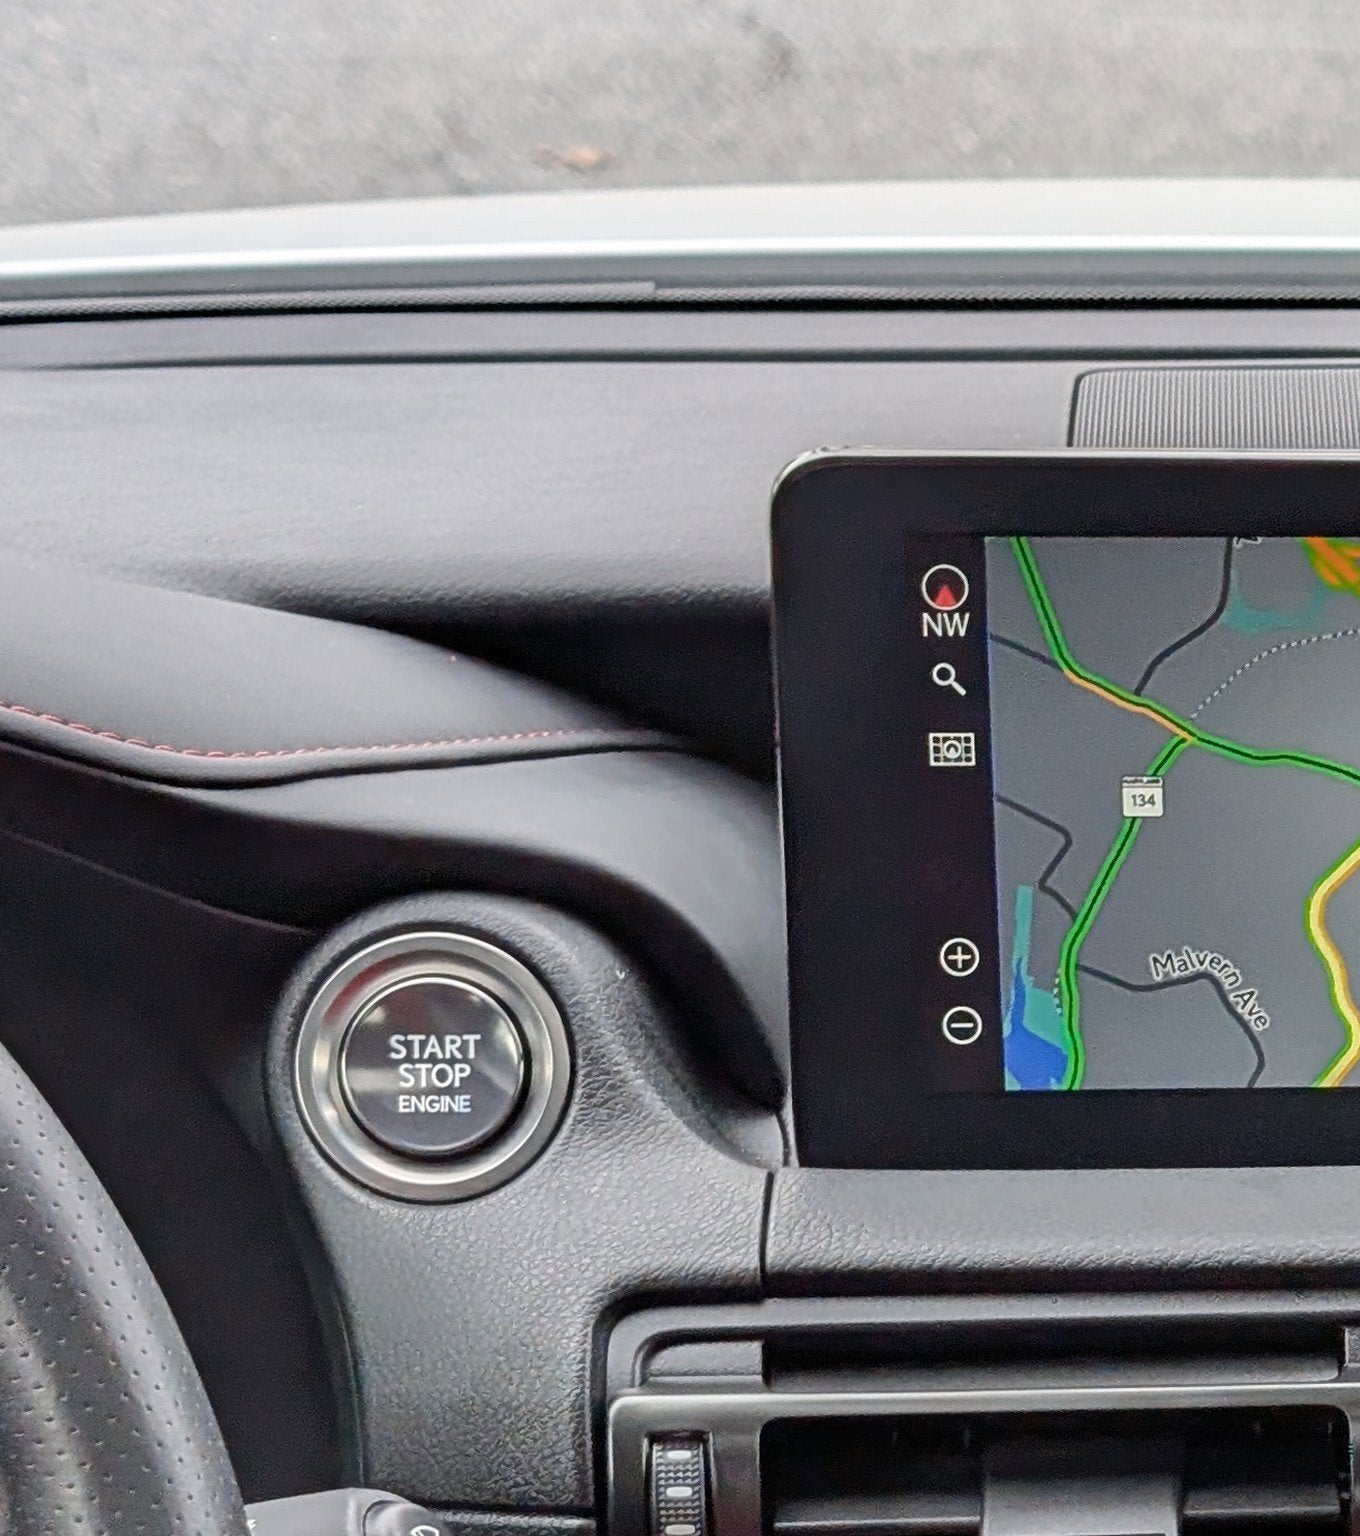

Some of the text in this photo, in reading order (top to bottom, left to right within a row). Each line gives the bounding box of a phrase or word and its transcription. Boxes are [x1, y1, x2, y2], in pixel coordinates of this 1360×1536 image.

[922, 612, 970, 637] NW
[1131, 793, 1156, 807] 134
[1151, 948, 1268, 1029] Malvern Ave
[389, 1033, 482, 1060] START
[398, 1063, 472, 1089] STOP
[397, 1094, 472, 1114] ENGINE
